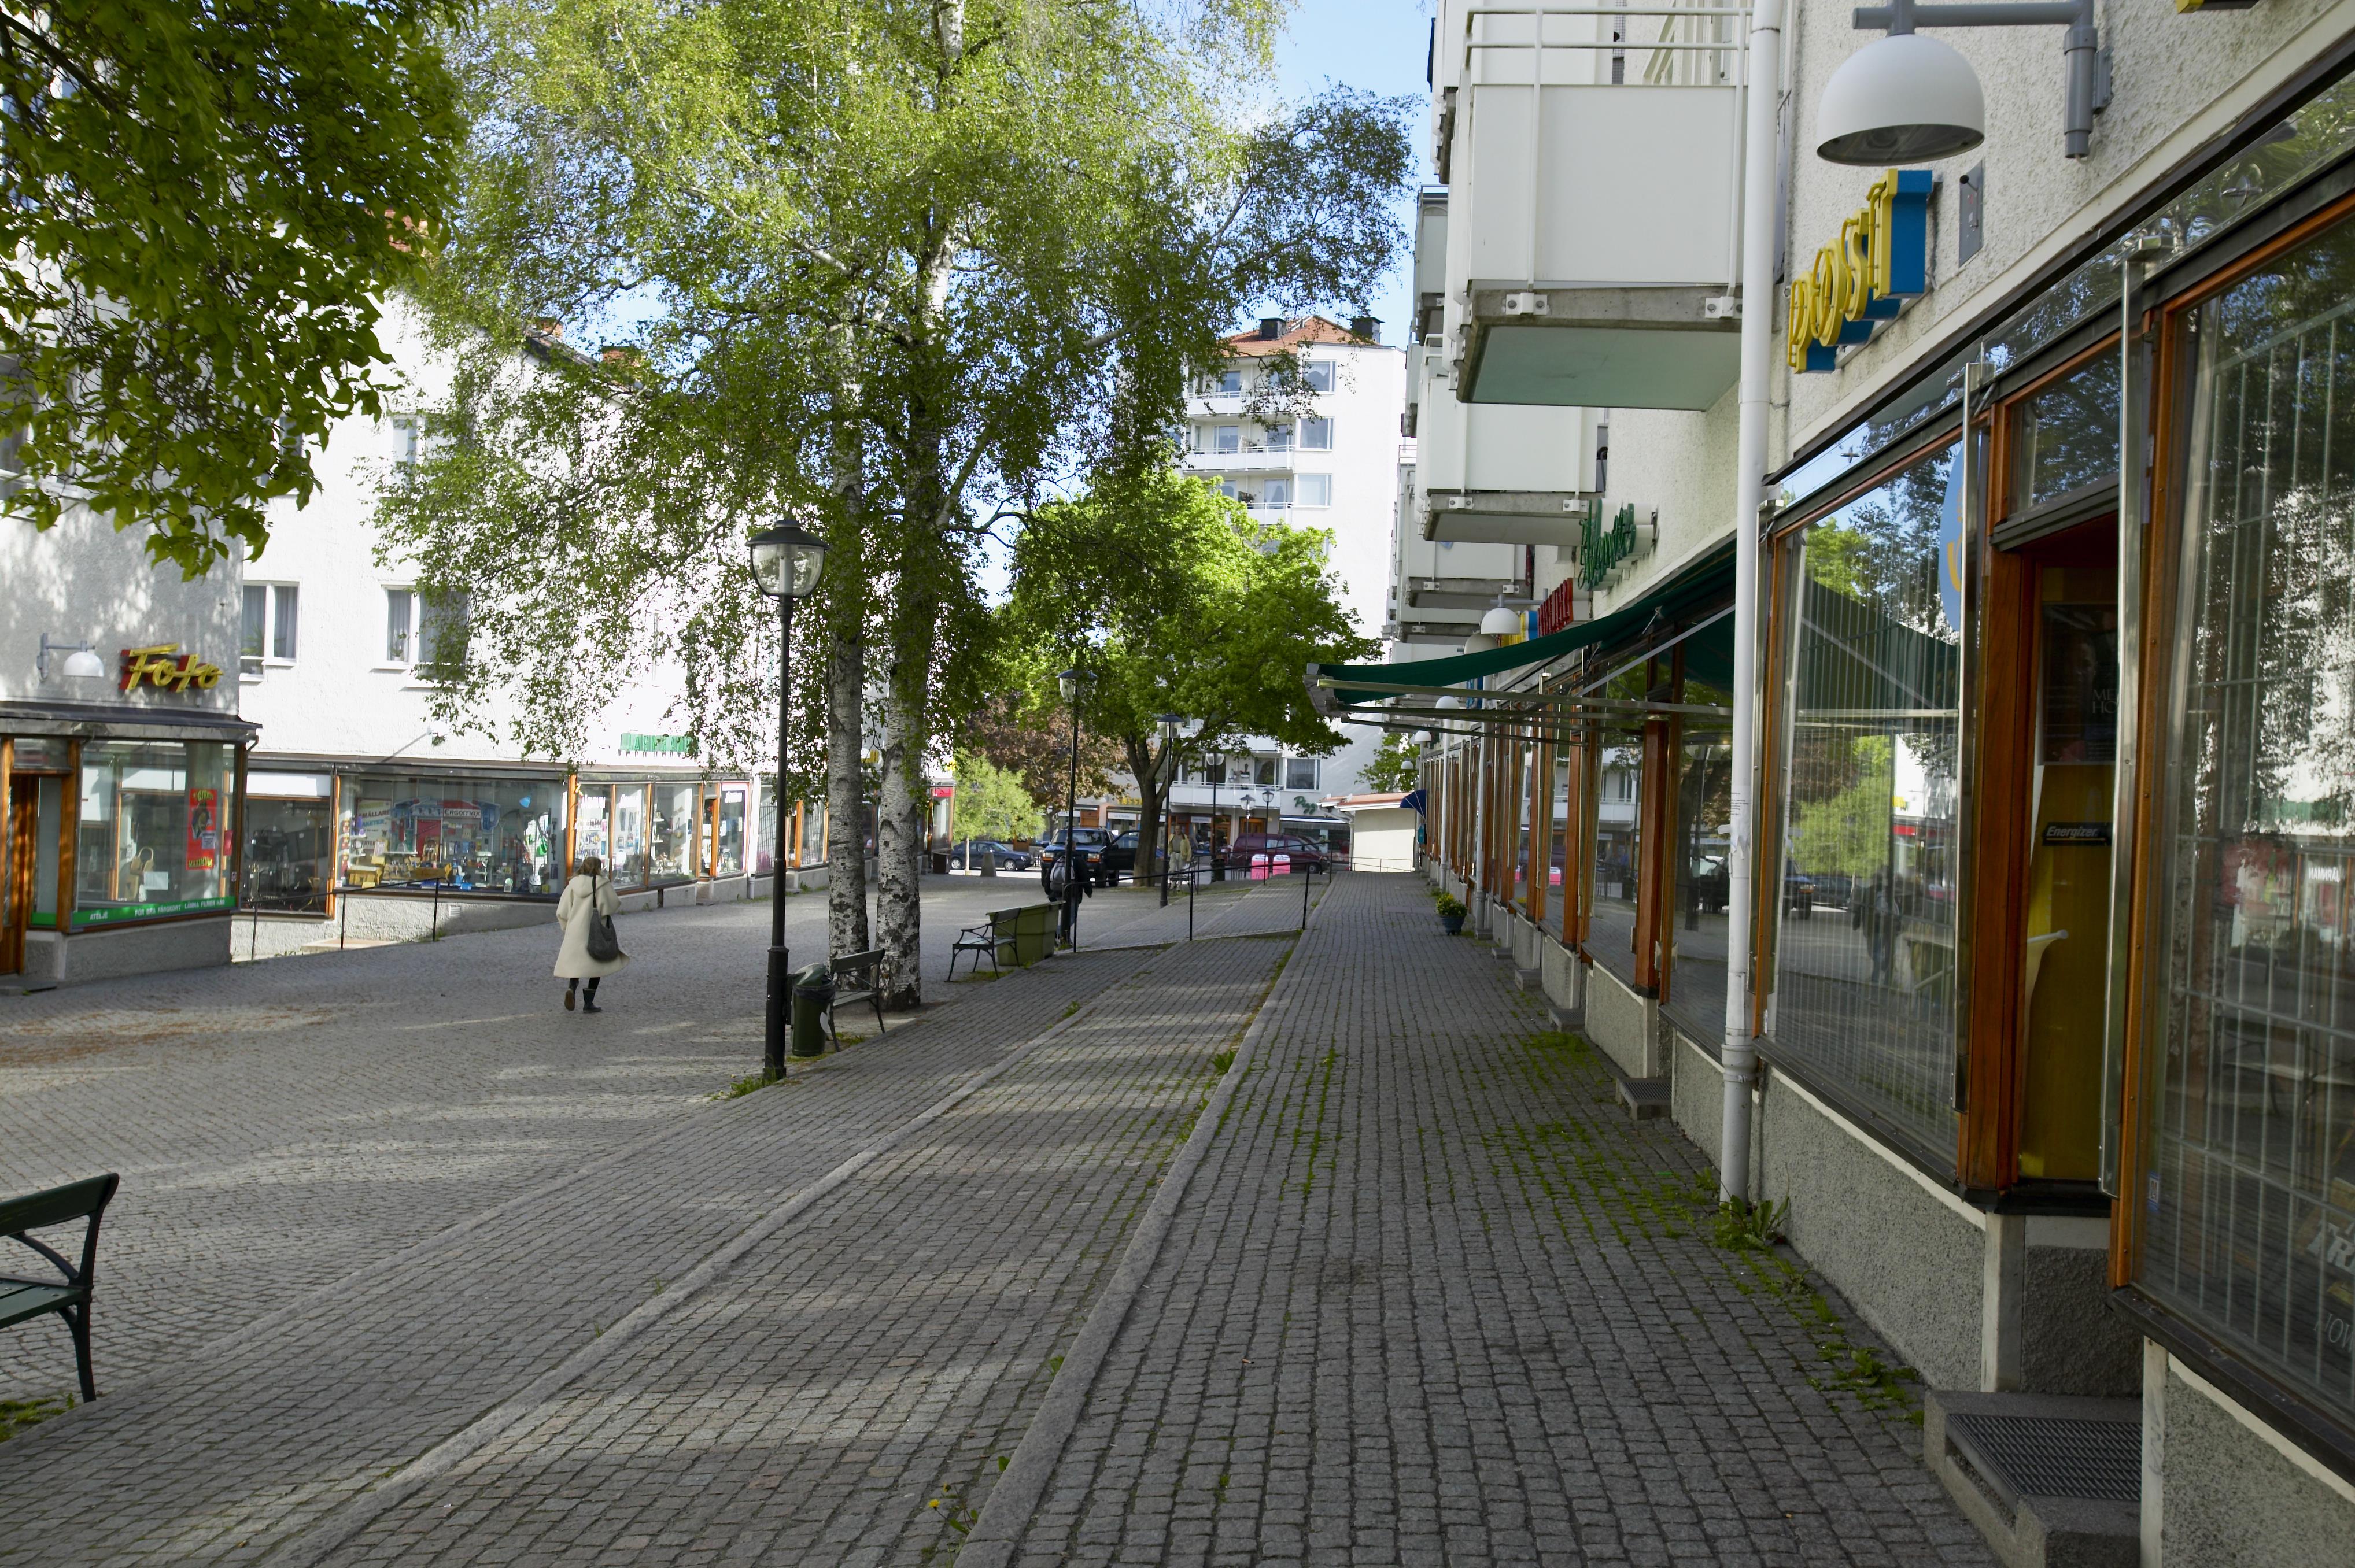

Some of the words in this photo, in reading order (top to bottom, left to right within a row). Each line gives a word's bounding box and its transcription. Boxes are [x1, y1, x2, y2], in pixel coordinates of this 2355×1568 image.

[1788, 168, 1903, 373] POST
[120, 642, 224, 693] Foto
[2046, 826, 2098, 840] Energizer
